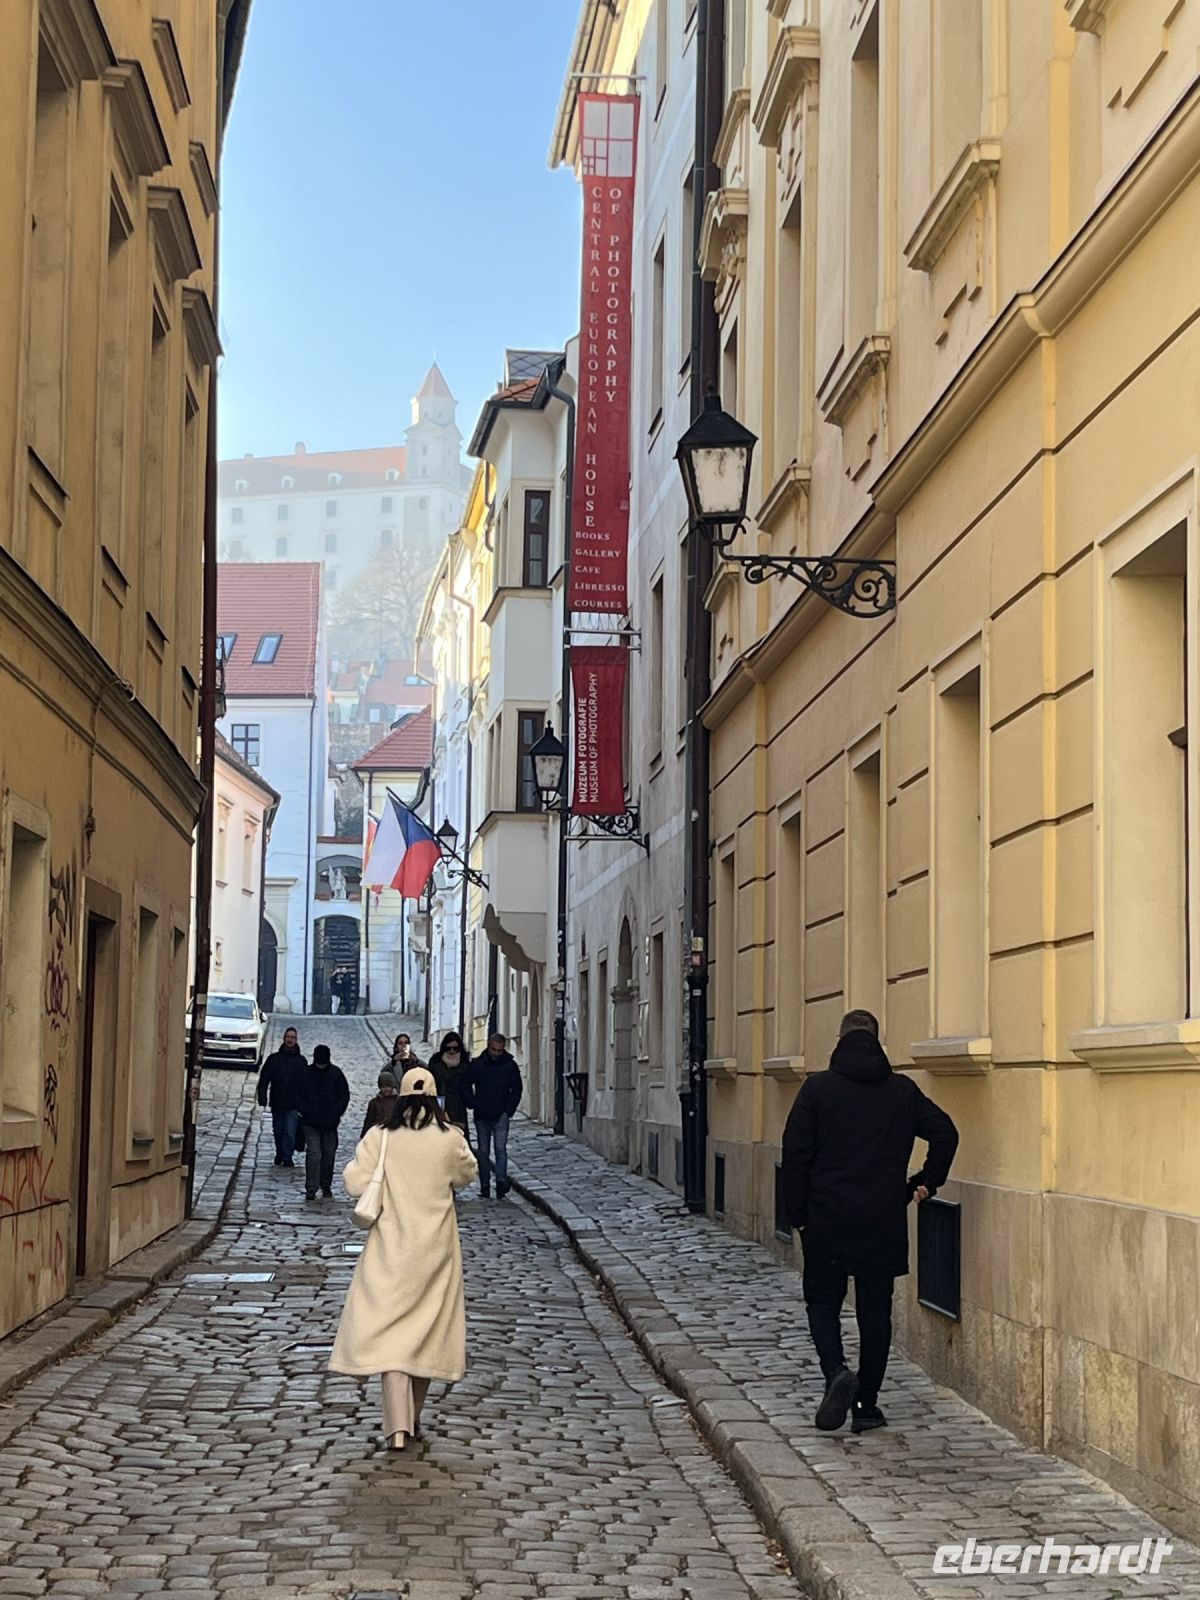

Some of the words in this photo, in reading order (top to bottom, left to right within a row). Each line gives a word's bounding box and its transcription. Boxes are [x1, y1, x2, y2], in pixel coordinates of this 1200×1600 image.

[609, 187, 622, 215] OF
[590, 186, 602, 293] CENTRAL
[605, 235, 621, 402] PHOTOGRAPHY
[587, 312, 599, 434] EUROPEAN
[585, 454, 596, 527] HOUSE
[575, 531, 610, 541] BOOKS
[575, 548, 621, 558] GALLERY
[574, 582, 625, 592] LIBRESSO
[574, 599, 622, 609] COURSES
[577, 697, 587, 757] FOTOGRAFIE
[588, 672, 599, 744] PHOTOGRAPHY
[589, 745, 599, 759] OF
[589, 761, 599, 803] MUSEUM
